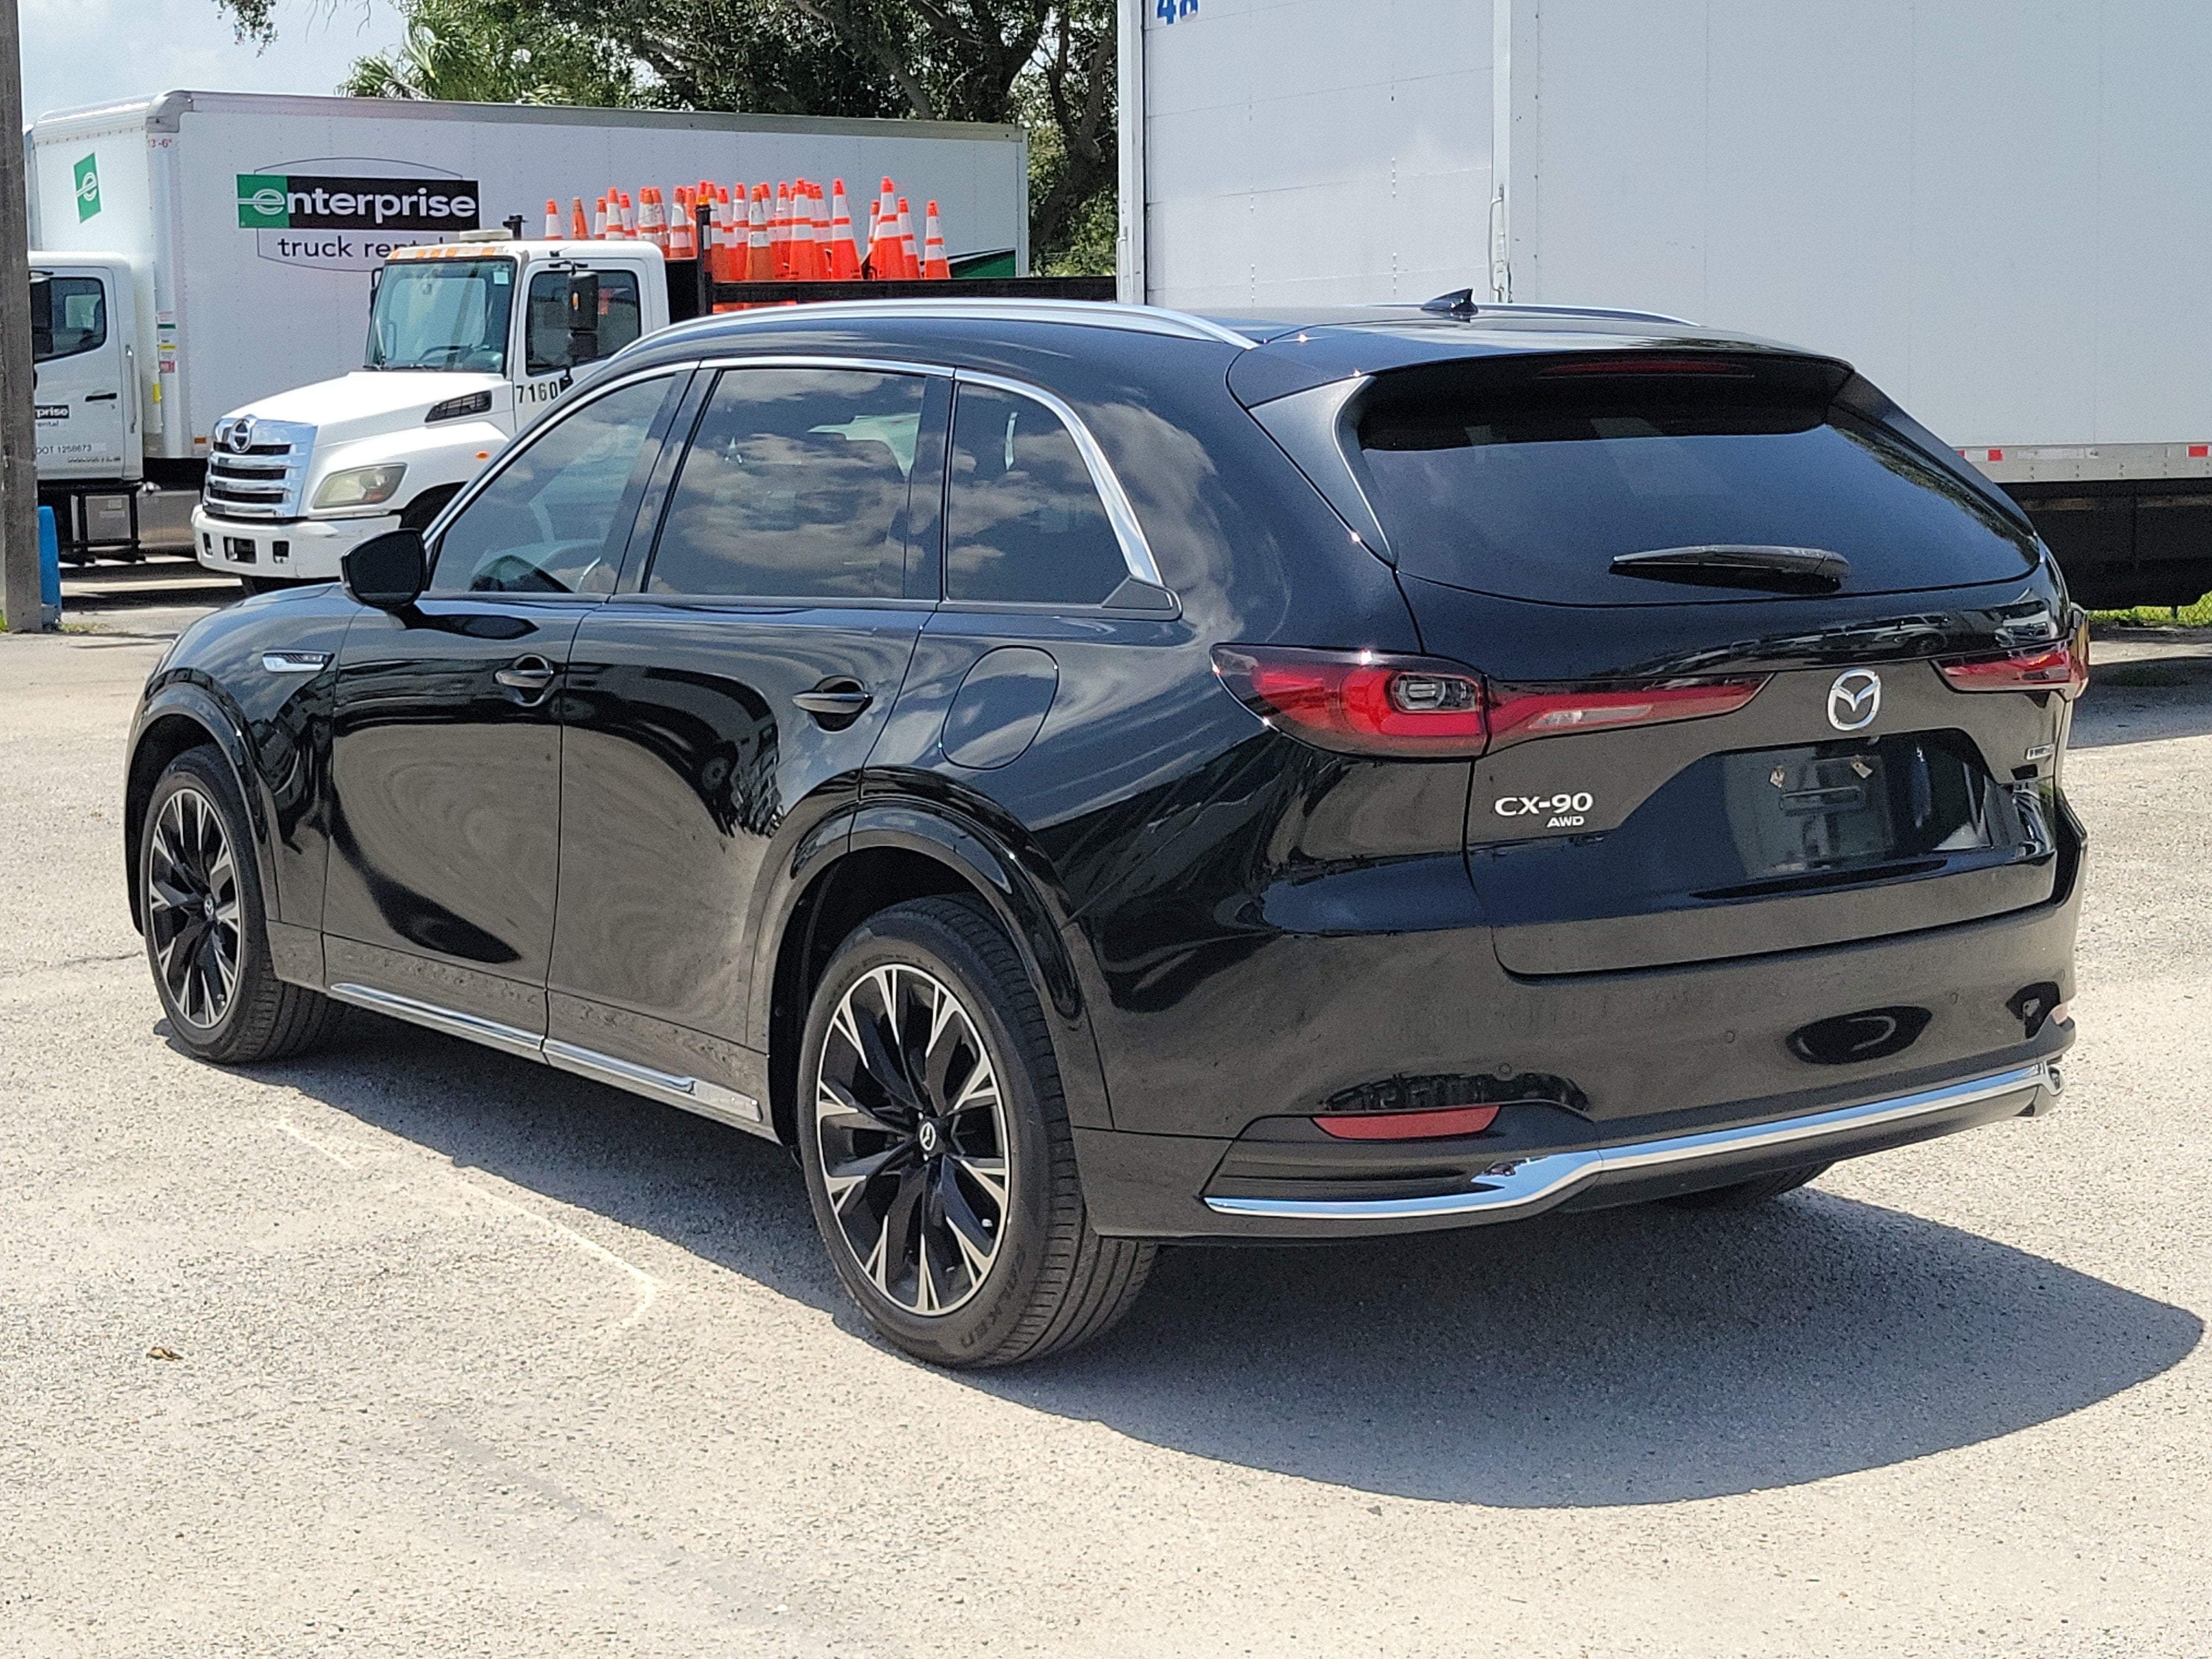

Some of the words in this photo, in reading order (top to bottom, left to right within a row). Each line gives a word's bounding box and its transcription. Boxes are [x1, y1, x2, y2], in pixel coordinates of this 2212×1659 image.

[237, 187, 476, 224] enterprise
[278, 235, 353, 257] truck
[1495, 792, 1593, 816] CX-90
[1547, 816, 1584, 828] AWD
